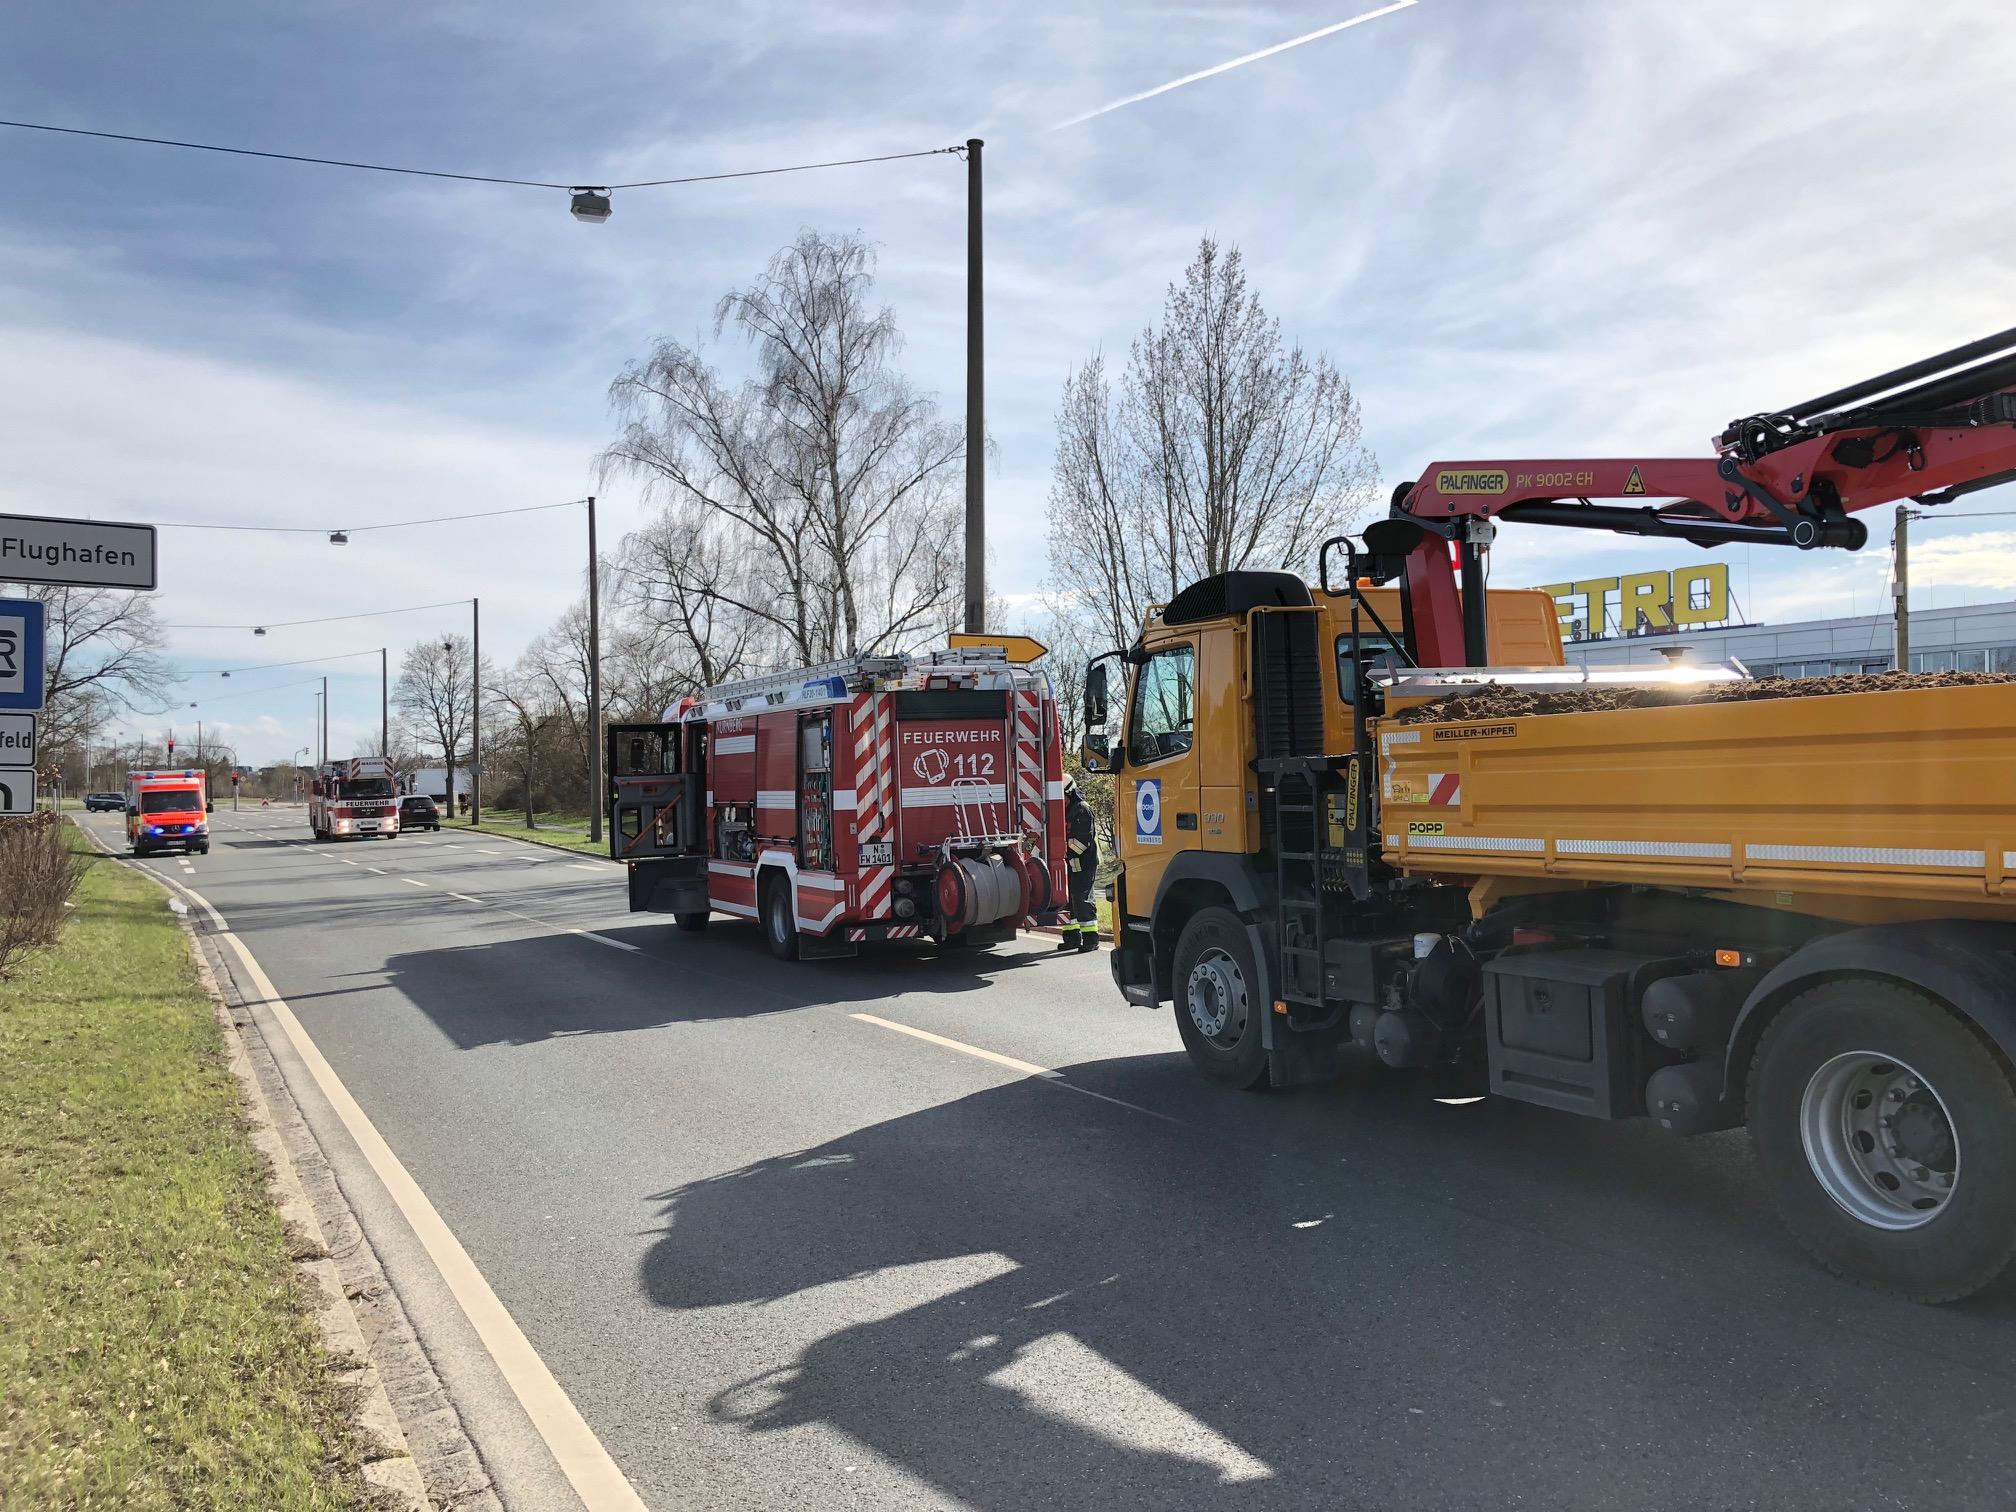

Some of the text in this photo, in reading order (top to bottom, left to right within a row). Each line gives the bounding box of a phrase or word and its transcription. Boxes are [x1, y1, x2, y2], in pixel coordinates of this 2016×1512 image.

[1440, 474, 1504, 490] PALFINGER
[1516, 473, 1533, 488] PK
[2, 537, 136, 566] Flughafen
[903, 730, 1001, 744] FEUERWEHR
[1435, 726, 1515, 740] MEILLER-KIPPER
[953, 752, 995, 776] 112
[1348, 763, 1358, 827] PALFINGER
[1409, 822, 1443, 834] POPP
[873, 844, 879, 854] N
[872, 853, 892, 864] 1401
